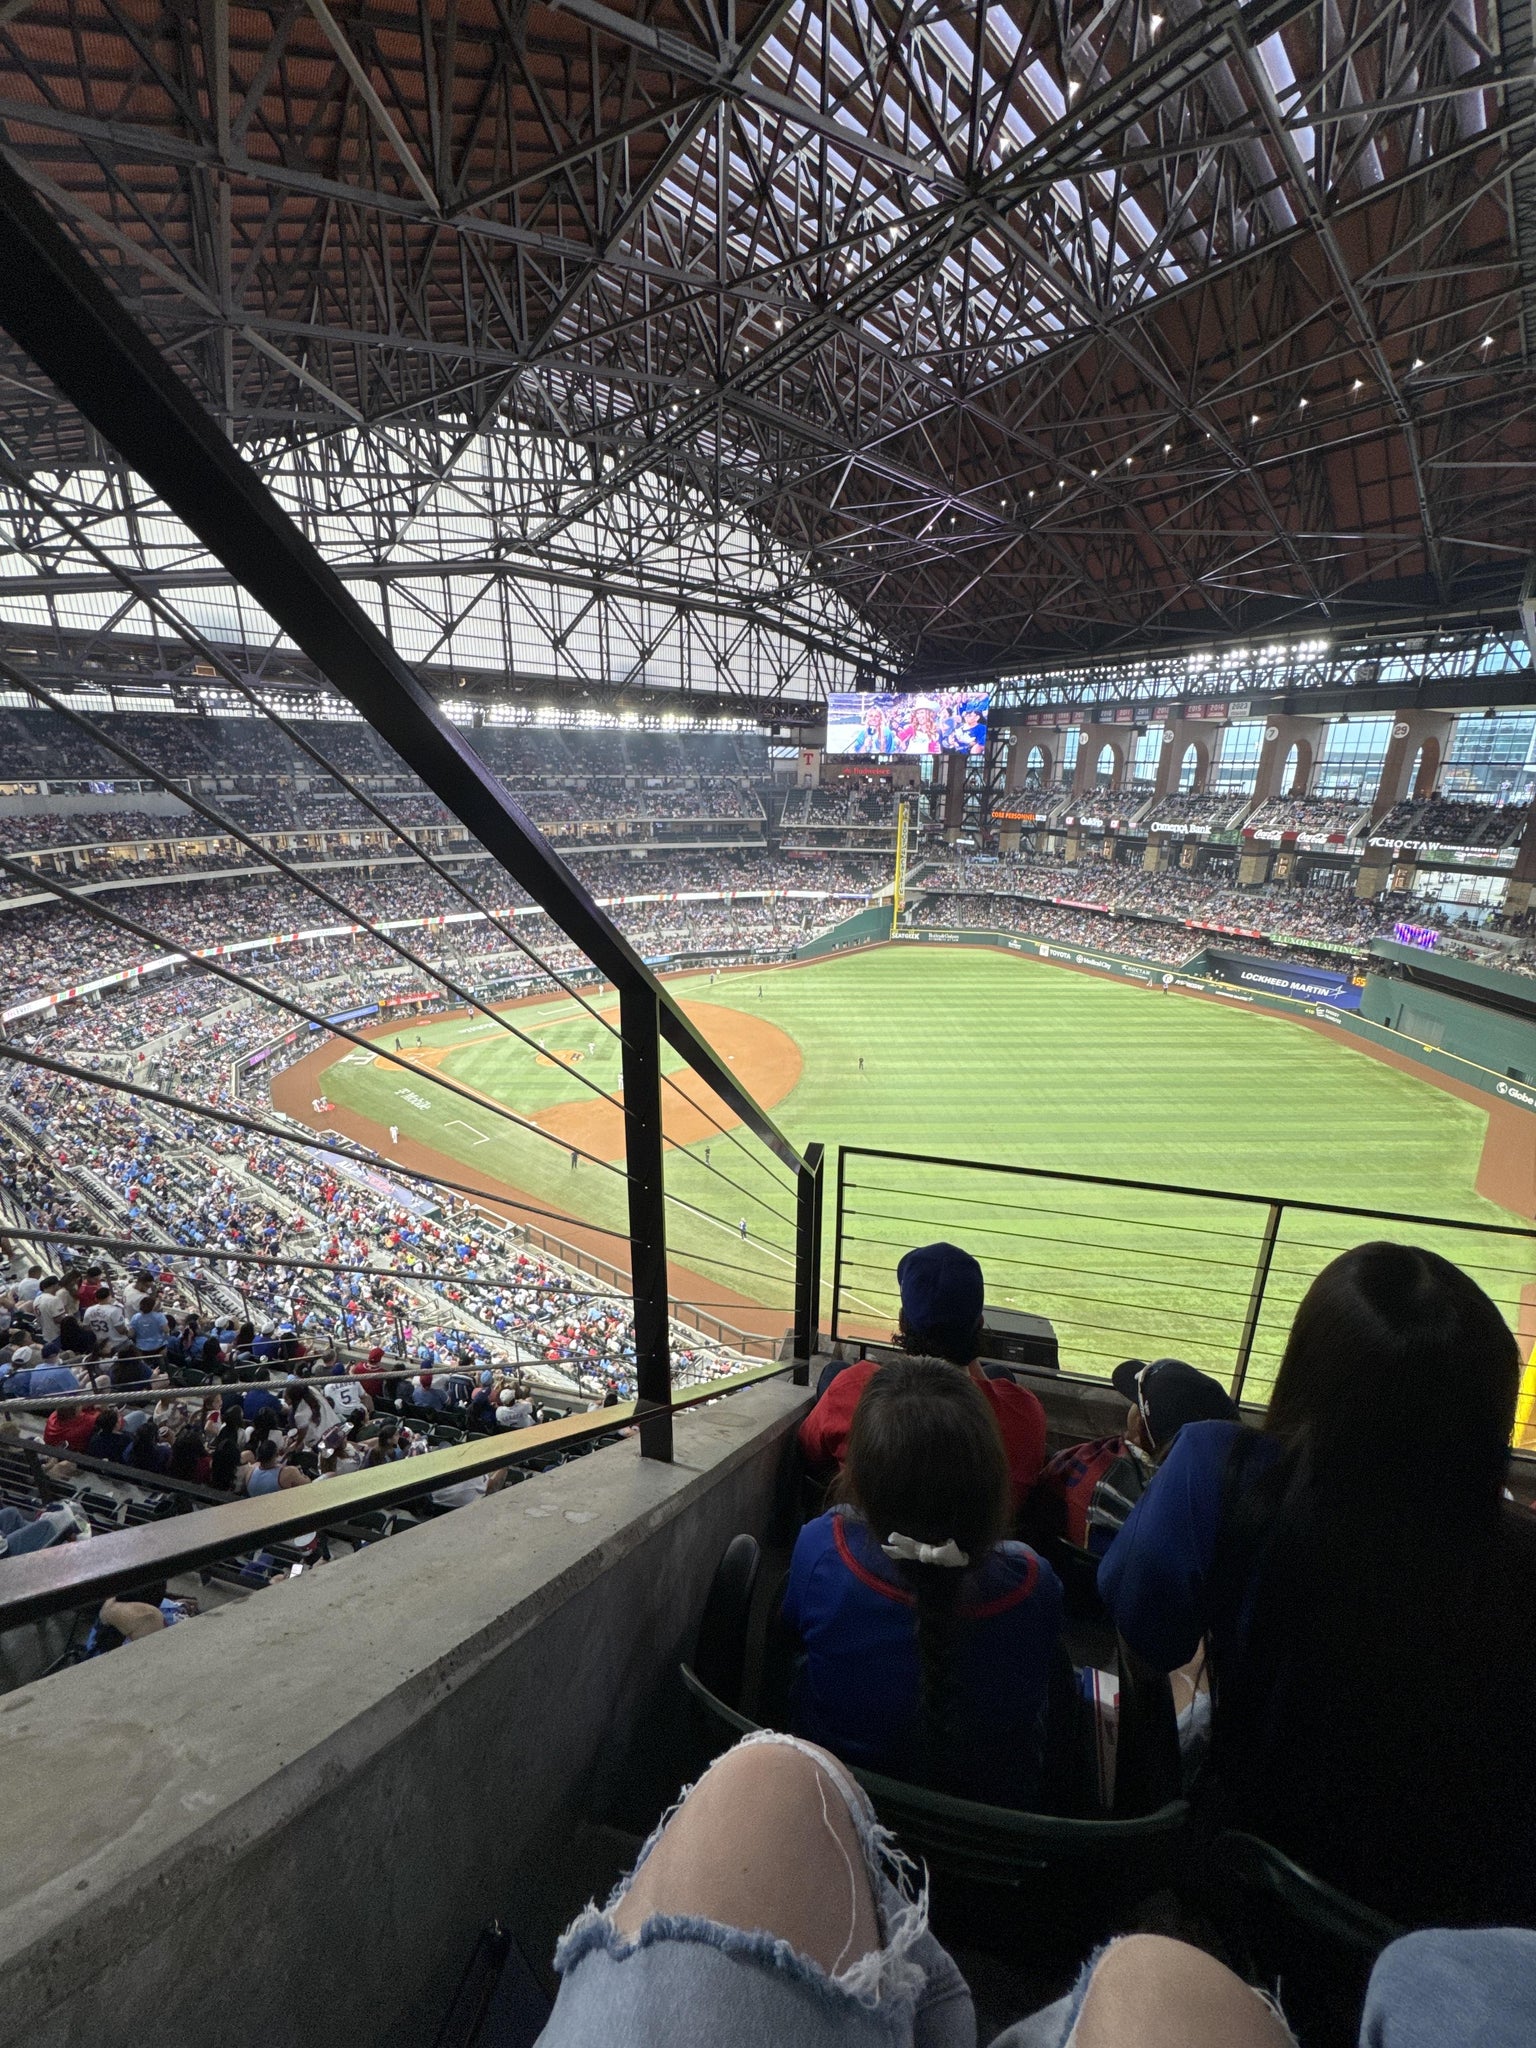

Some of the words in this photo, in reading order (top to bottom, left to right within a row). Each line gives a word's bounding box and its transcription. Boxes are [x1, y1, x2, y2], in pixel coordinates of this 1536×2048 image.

[1394, 726, 1408, 735] 29
[803, 753, 814, 765] T
[1189, 824, 1212, 834] Bank
[1374, 837, 1440, 850] CHOCTAW
[891, 932, 920, 940] SEATGEEK
[1278, 935, 1309, 946] LUXOR
[1311, 940, 1357, 955] STAFFING
[1049, 949, 1071, 960] TOYOTA
[1240, 971, 1289, 988] LOCKHEED
[1289, 981, 1330, 996] MARTIN
[1508, 1087, 1534, 1105] Globe
[90, 1320, 109, 1332] 53
[340, 1389, 351, 1405] 5
